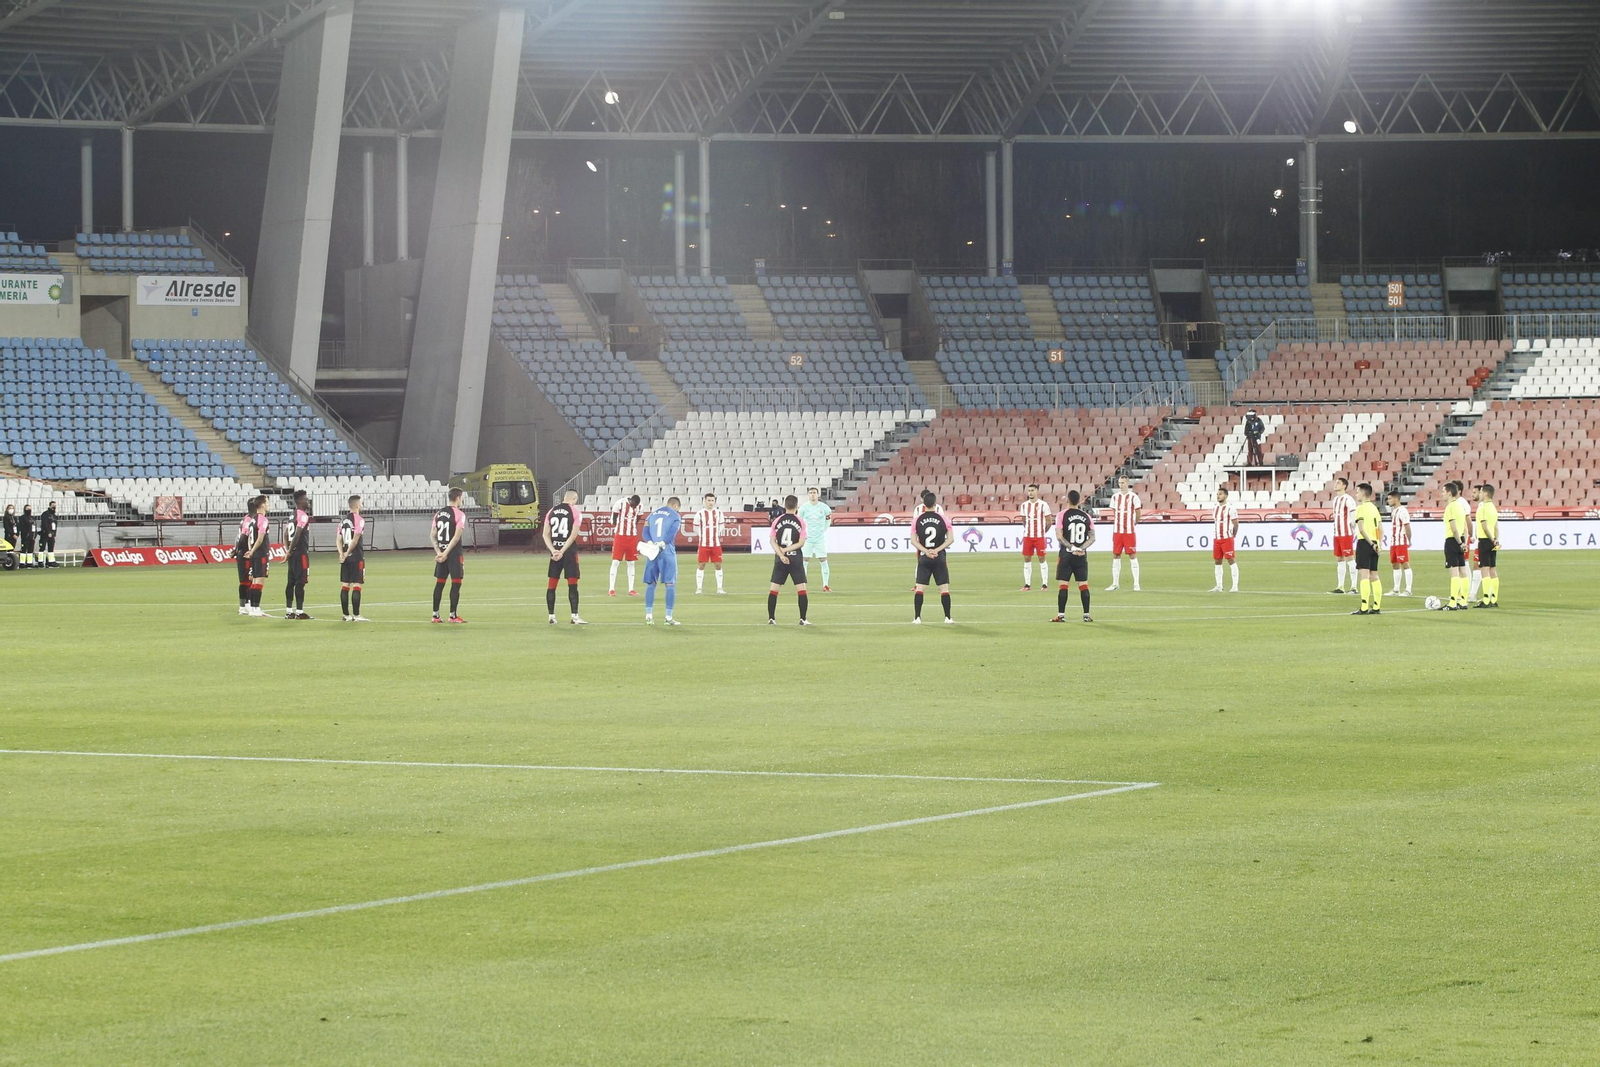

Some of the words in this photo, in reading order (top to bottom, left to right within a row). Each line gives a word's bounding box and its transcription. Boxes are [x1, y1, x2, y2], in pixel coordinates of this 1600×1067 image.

[2, 280, 38, 289] URANTE
[166, 281, 236, 297] Alresde
[790, 356, 802, 366] 52
[1051, 352, 1062, 361] 51
[437, 521, 450, 541] 21
[550, 517, 569, 538] 24
[655, 518, 663, 537] 1
[1068, 523, 1086, 543] 18
[781, 528, 793, 546] 4
[864, 538, 912, 549] COST
[925, 527, 937, 547] 2
[1529, 533, 1597, 546] COSTA
[113, 550, 145, 564] LaLiga
[165, 548, 198, 562] LaLiga
